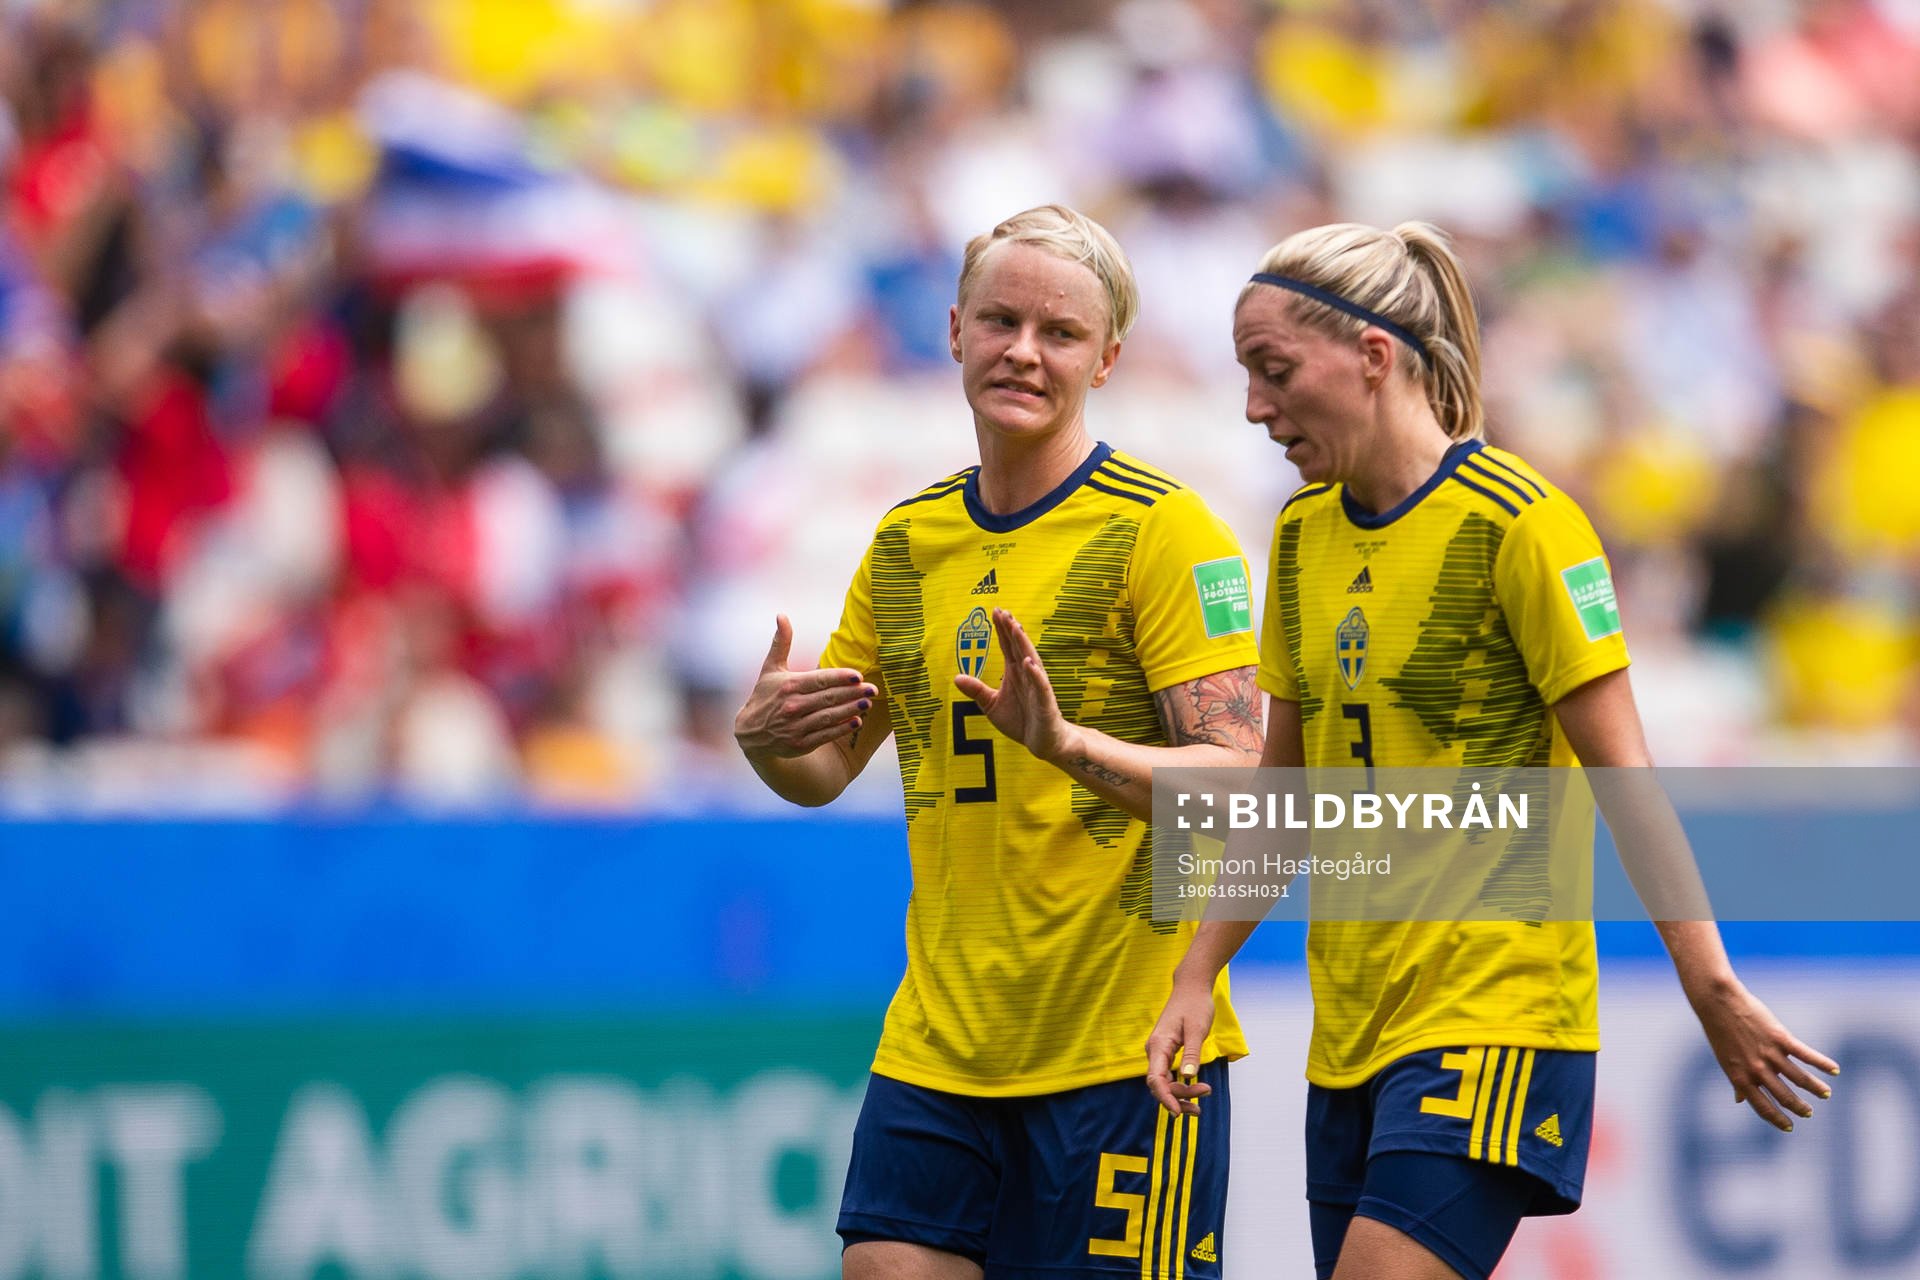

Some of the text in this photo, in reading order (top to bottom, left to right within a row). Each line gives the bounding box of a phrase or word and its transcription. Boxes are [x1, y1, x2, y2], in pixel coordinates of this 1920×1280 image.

[971, 585, 999, 595] adidas
[1202, 577, 1246, 592] LIVING
[1204, 585, 1247, 600] FOOTBALL
[952, 701, 997, 803] 5
[1341, 703, 1376, 804] 3
[1419, 1046, 1484, 1119] 3
[1088, 1151, 1149, 1257] 5
[1191, 1248, 1217, 1263] adidas
